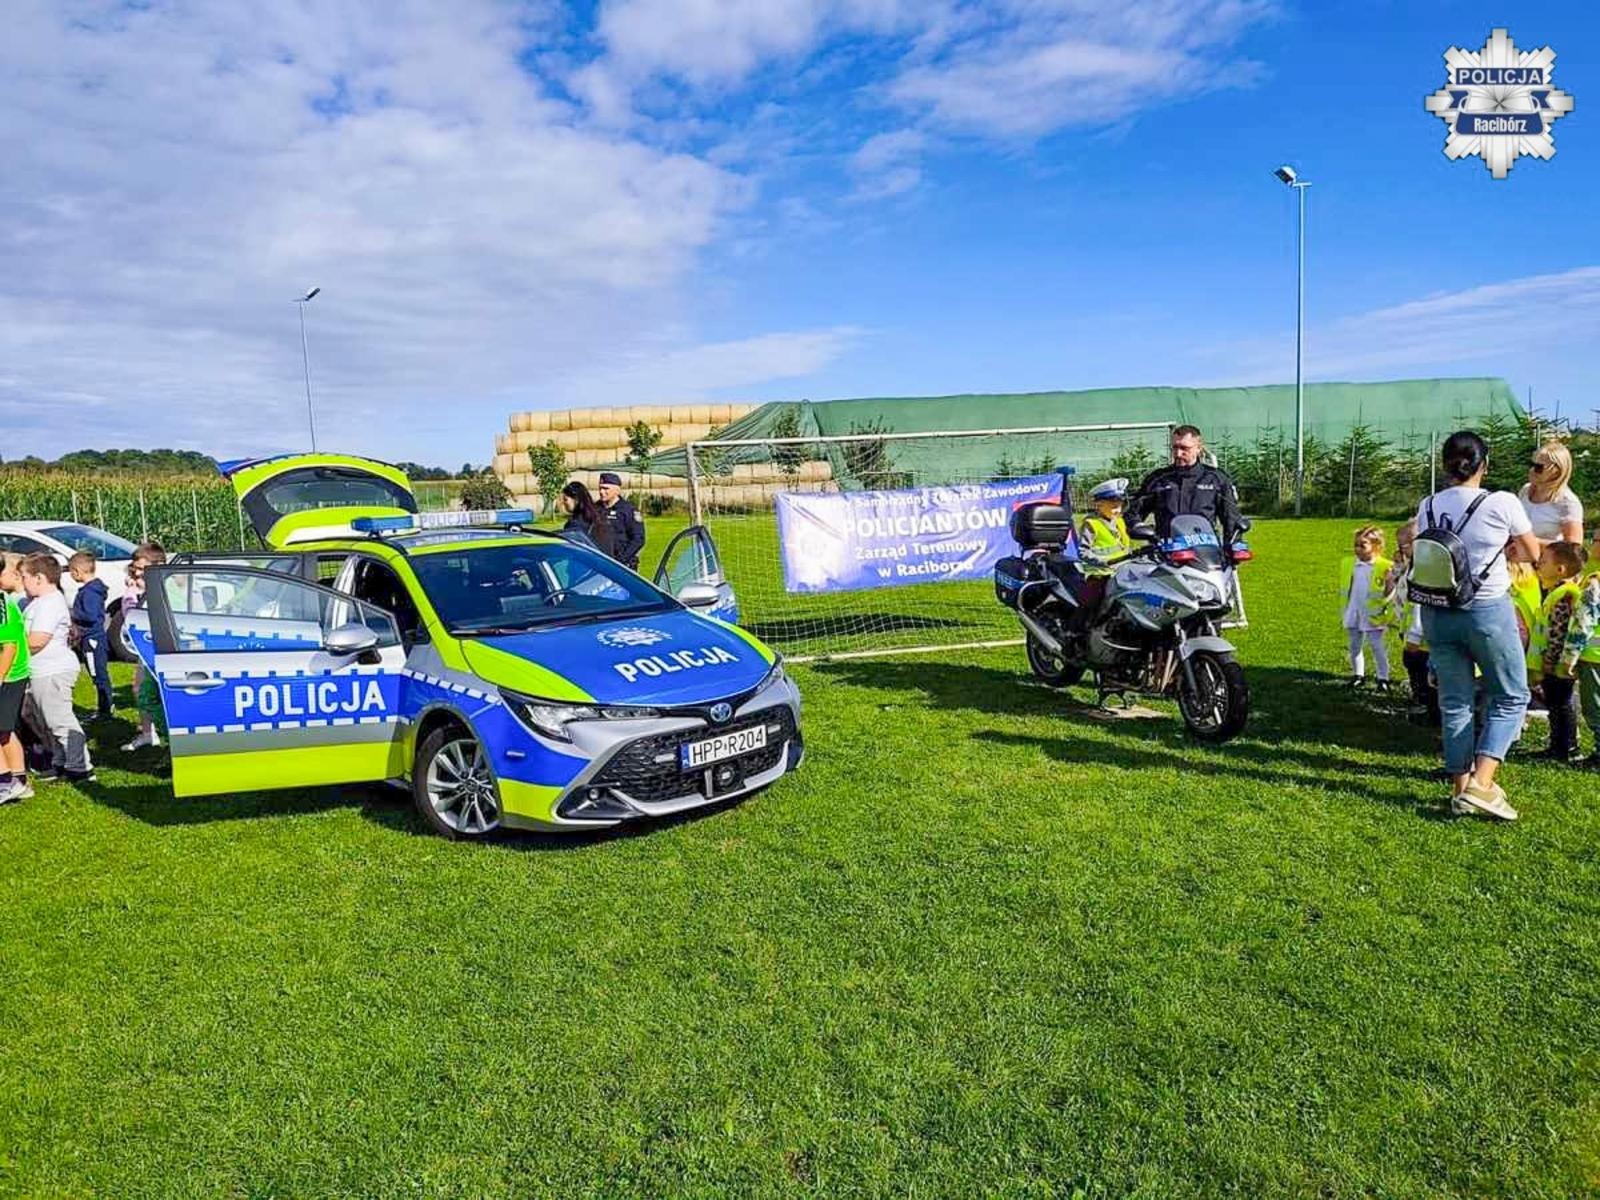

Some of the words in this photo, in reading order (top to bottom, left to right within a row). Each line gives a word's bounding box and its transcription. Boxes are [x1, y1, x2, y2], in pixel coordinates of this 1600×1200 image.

[983, 481, 1049, 499] Zawodowy
[854, 543, 907, 560] Zarząd
[912, 540, 987, 556] Terenowy
[877, 567, 892, 577] w
[614, 646, 740, 682] POLICJA
[234, 680, 387, 718] POLICJA
